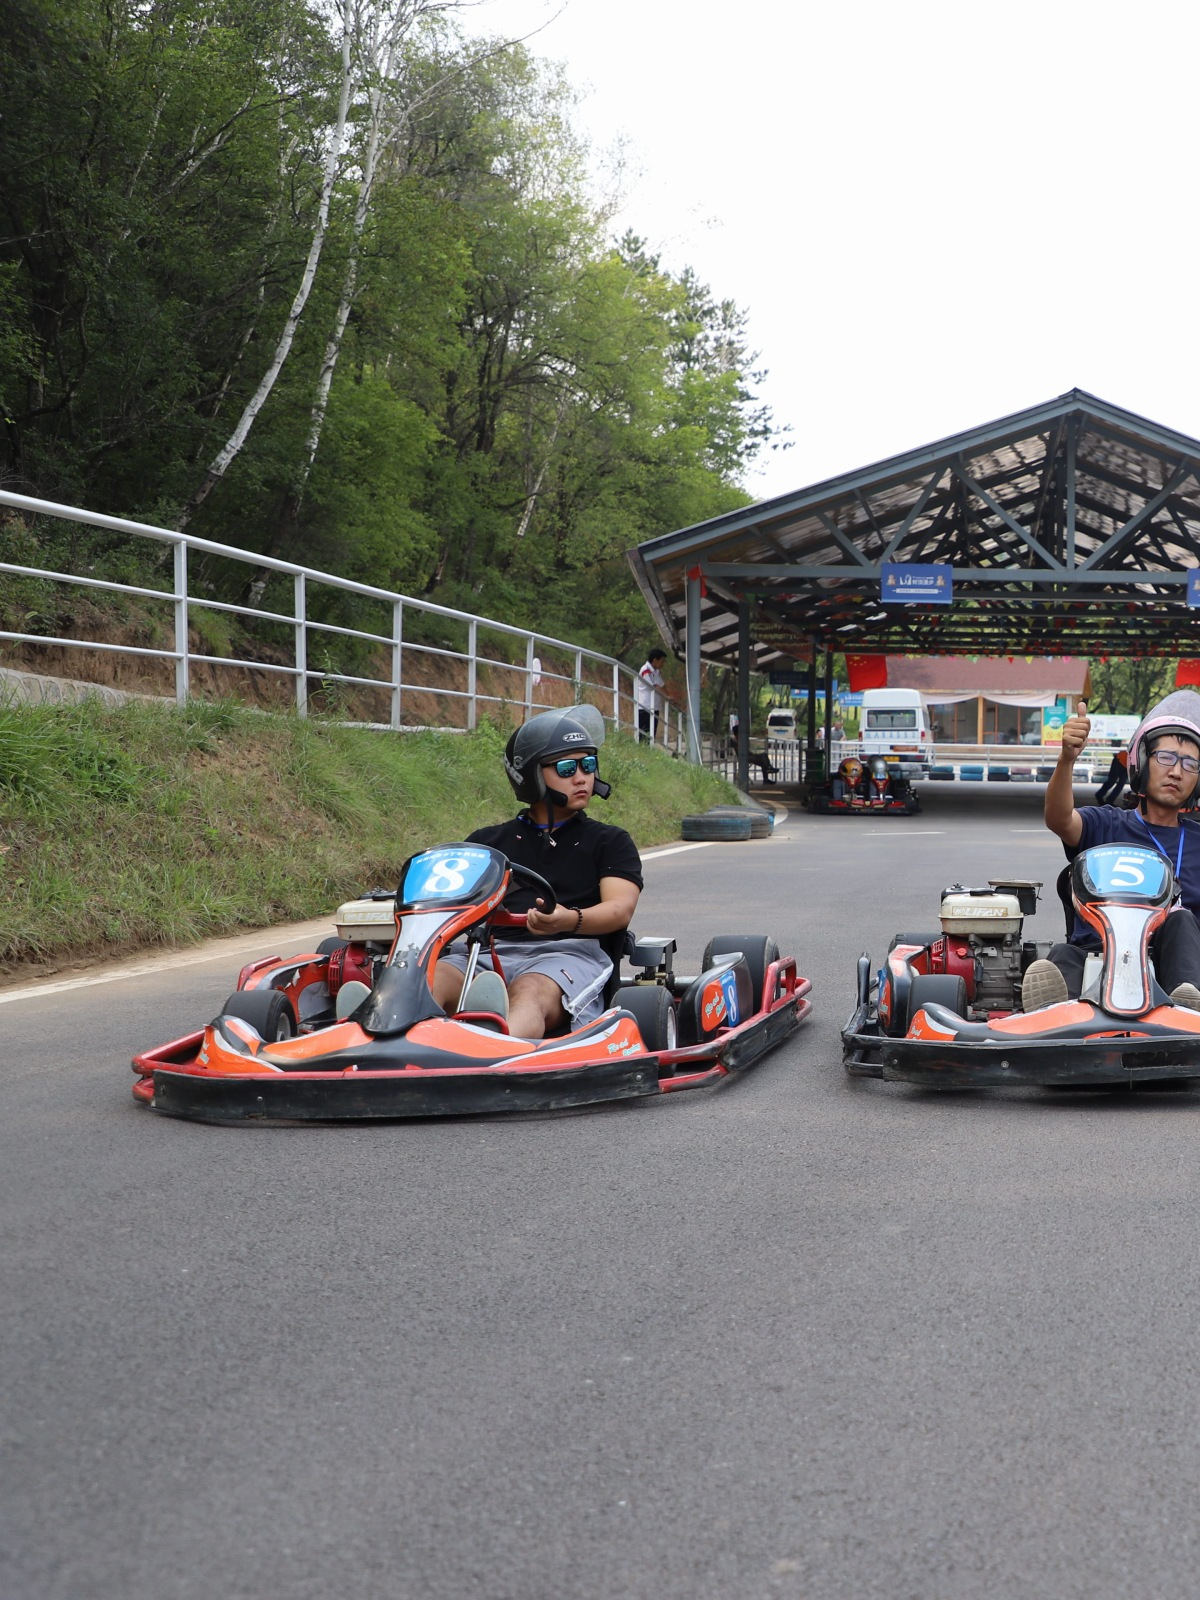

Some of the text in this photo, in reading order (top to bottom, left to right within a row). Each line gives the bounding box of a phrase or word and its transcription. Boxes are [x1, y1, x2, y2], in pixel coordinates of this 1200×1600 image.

[424, 858, 470, 893] 8
[1110, 856, 1145, 887] 5
[965, 907, 1004, 917] LIFAN
[728, 985, 737, 1022] 8
